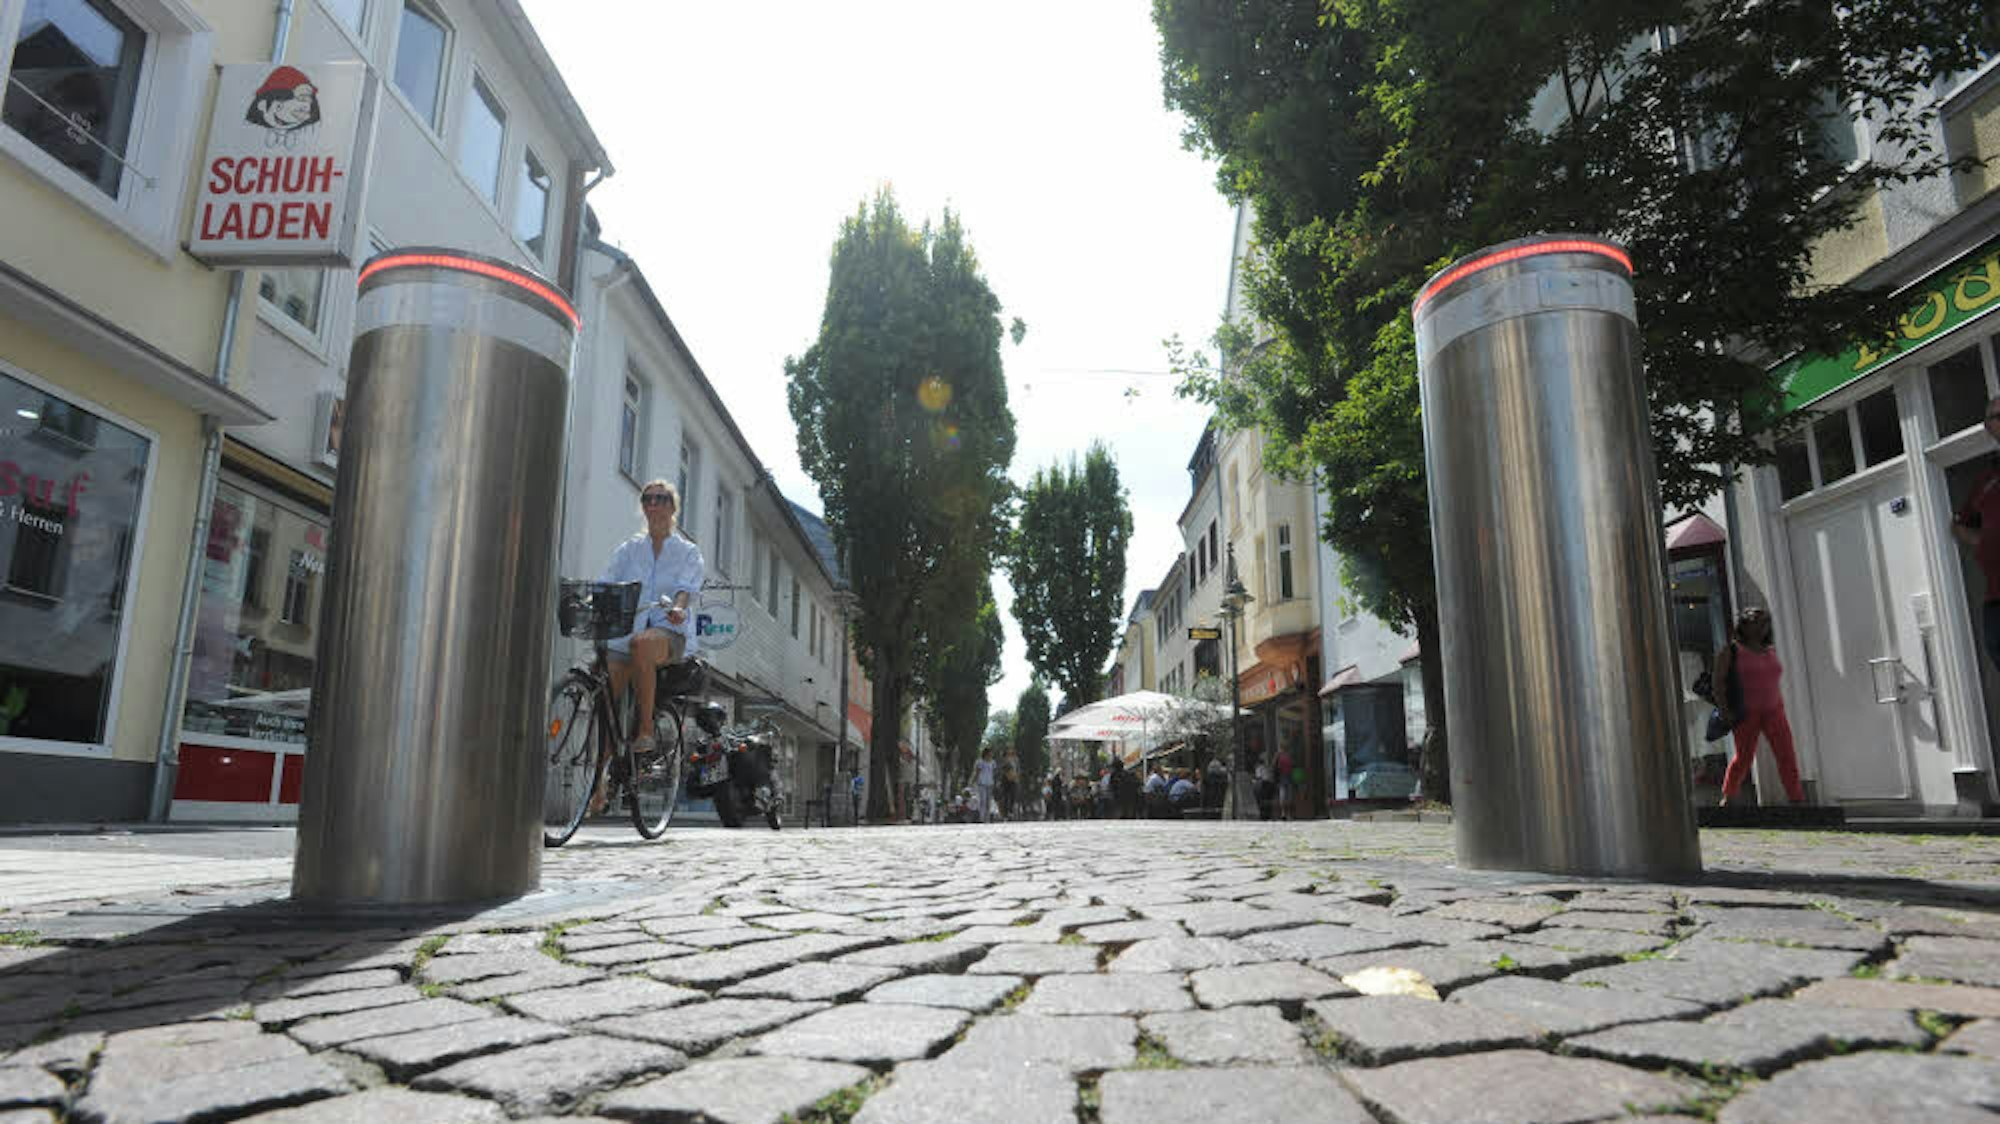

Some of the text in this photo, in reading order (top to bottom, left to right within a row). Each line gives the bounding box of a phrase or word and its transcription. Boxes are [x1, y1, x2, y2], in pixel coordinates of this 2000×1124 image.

[209, 155, 343, 194] SCHUH-
[200, 202, 332, 240] LADEN
[10, 504, 64, 535] Herren
